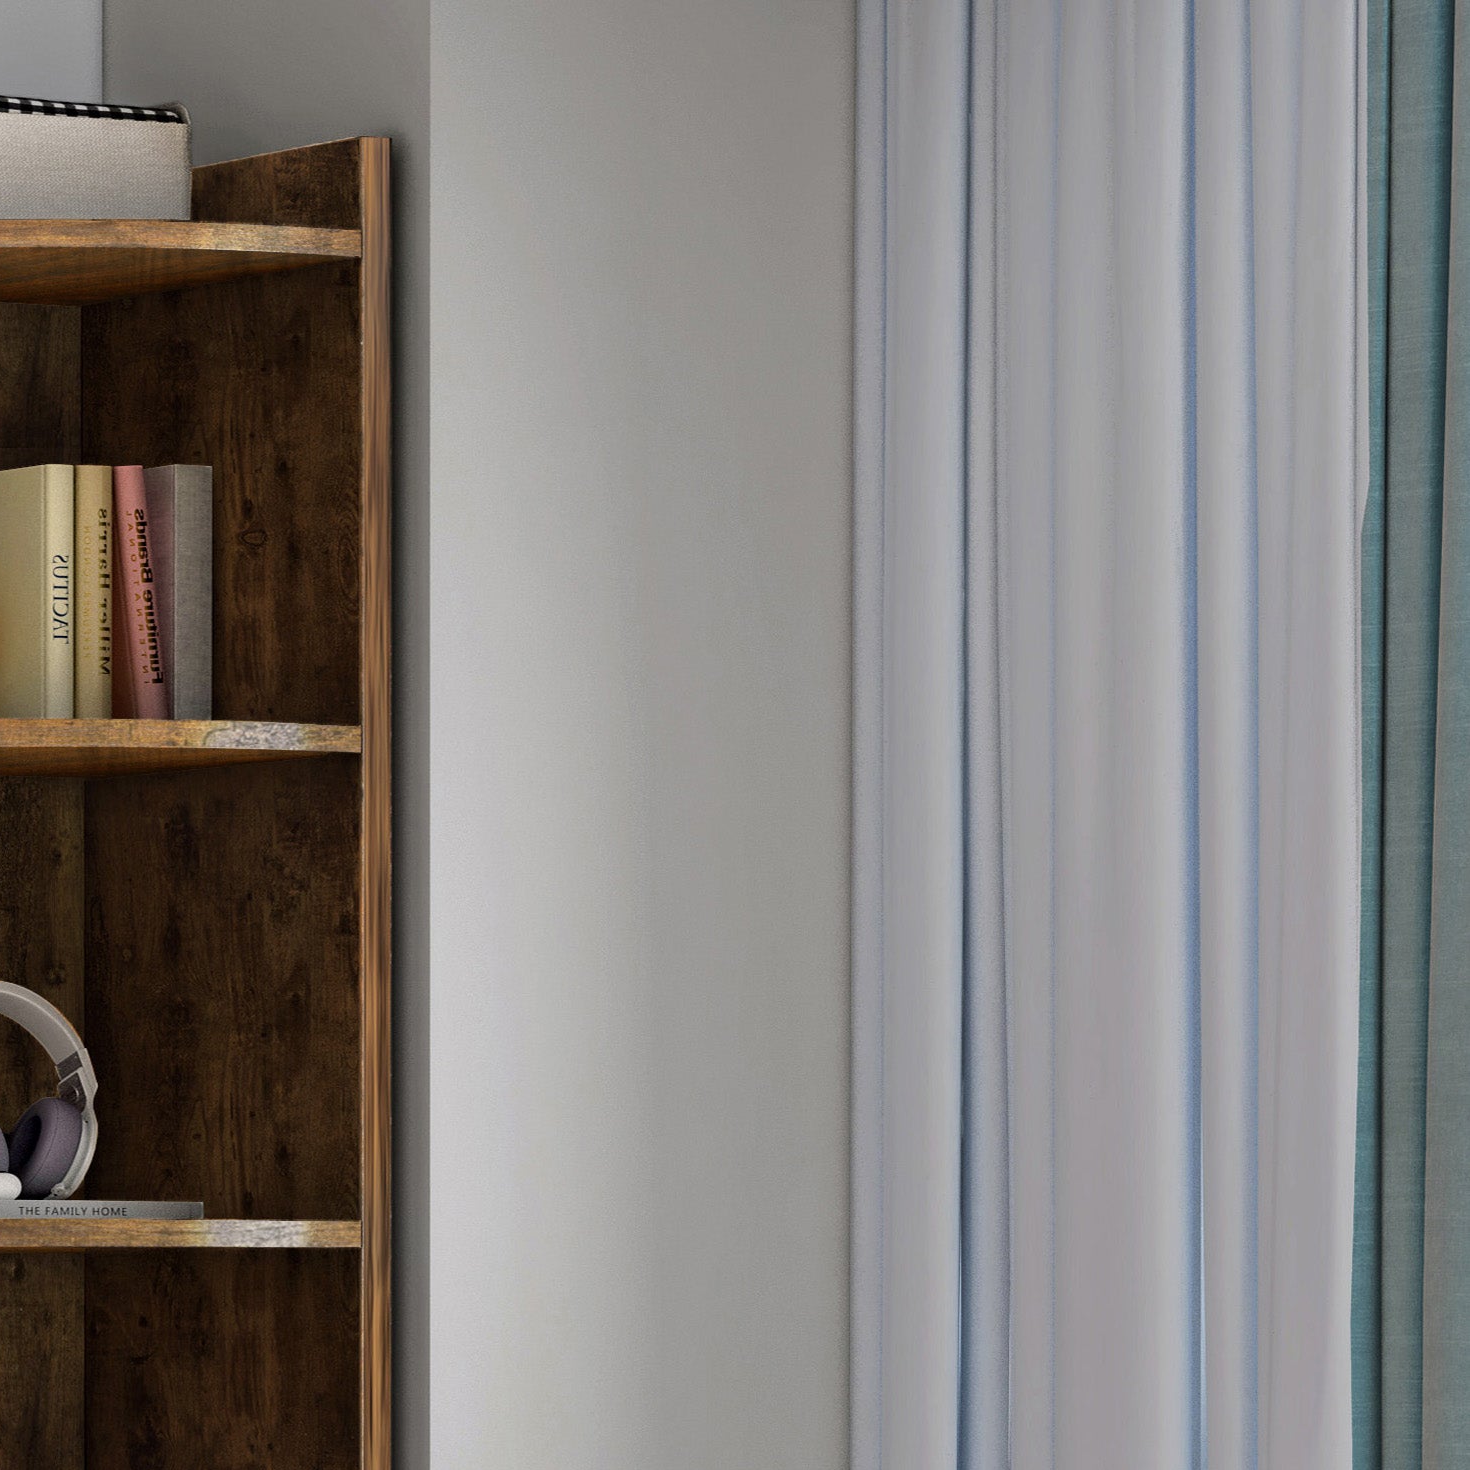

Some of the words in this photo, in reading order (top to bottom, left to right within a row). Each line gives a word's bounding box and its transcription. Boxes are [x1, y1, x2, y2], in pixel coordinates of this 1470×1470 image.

[19, 1206, 41, 1216] THE
[45, 1206, 88, 1216] FAMILY
[92, 1207, 128, 1217] HOME
